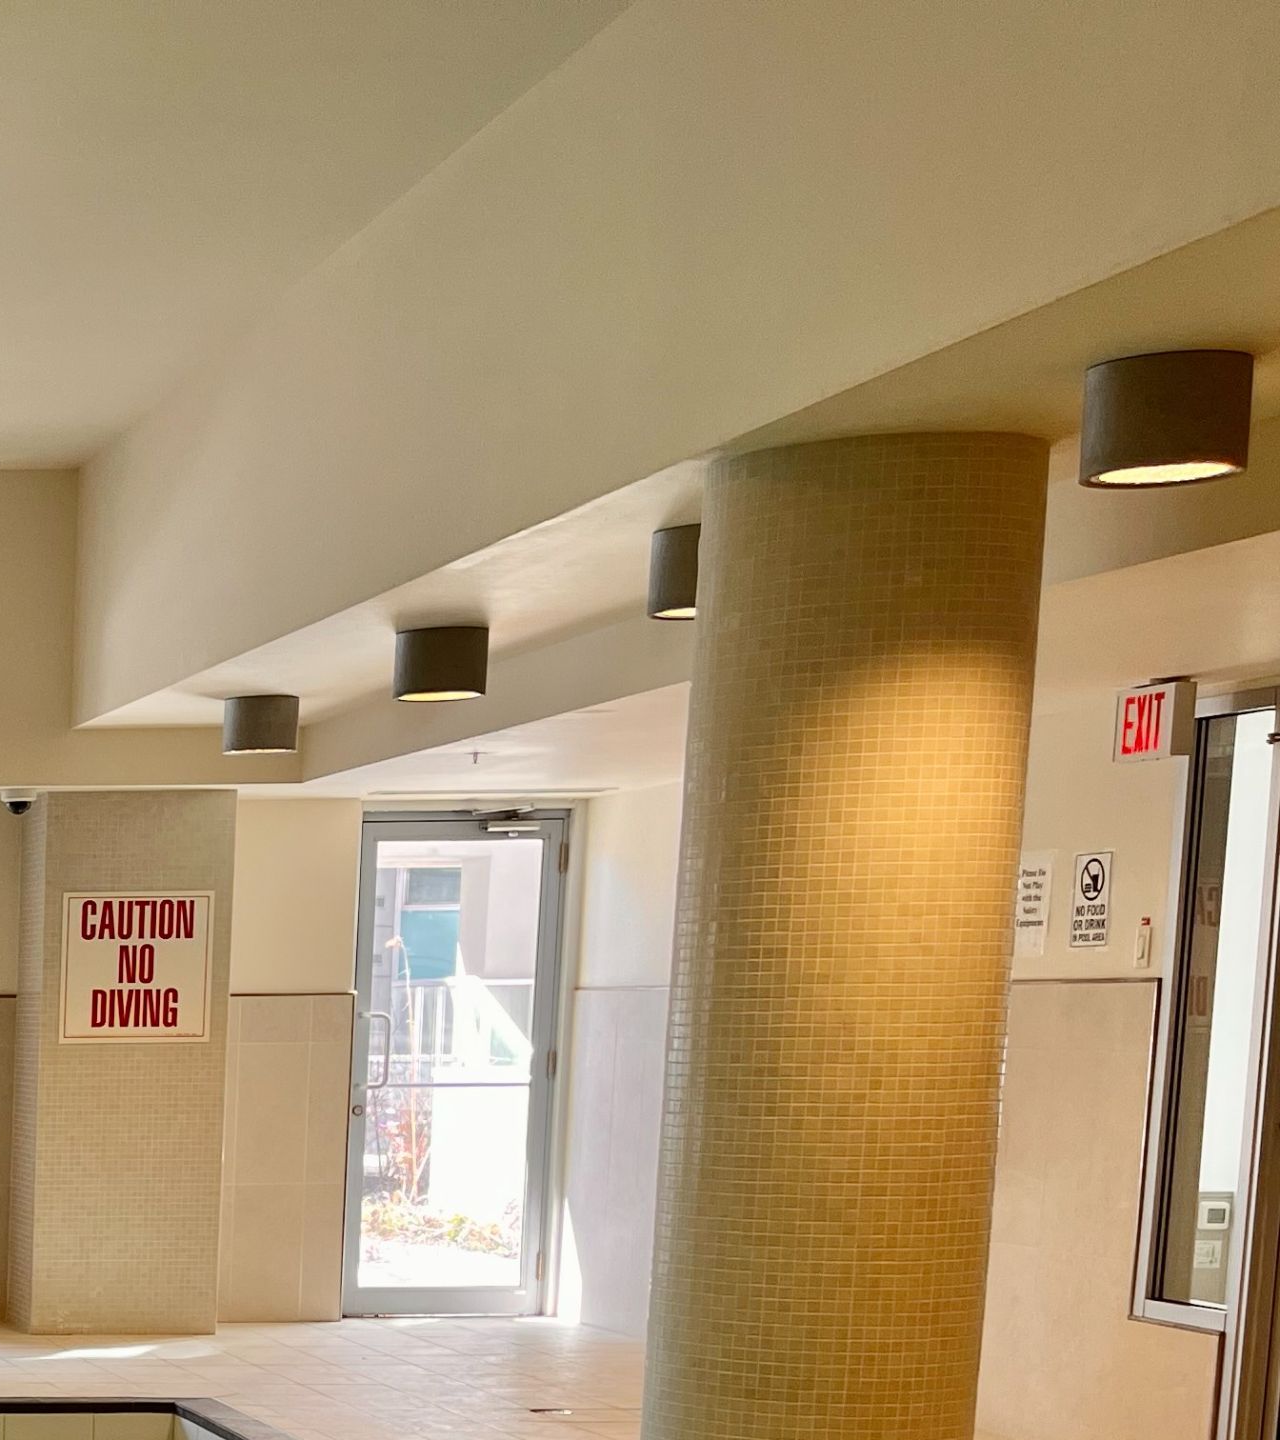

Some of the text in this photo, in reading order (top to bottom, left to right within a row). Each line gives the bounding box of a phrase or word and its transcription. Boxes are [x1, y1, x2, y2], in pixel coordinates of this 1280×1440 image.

[1121, 691, 1166, 755] EXIT
[80, 899, 195, 941] CAUTION
[1073, 918, 1106, 931] OR DRINK
[1075, 904, 1106, 917] NO FOOD
[1078, 933, 1091, 942] POOL
[1092, 932, 1105, 942] AREA
[118, 943, 155, 984] NO
[91, 987, 179, 1028] DIVING
